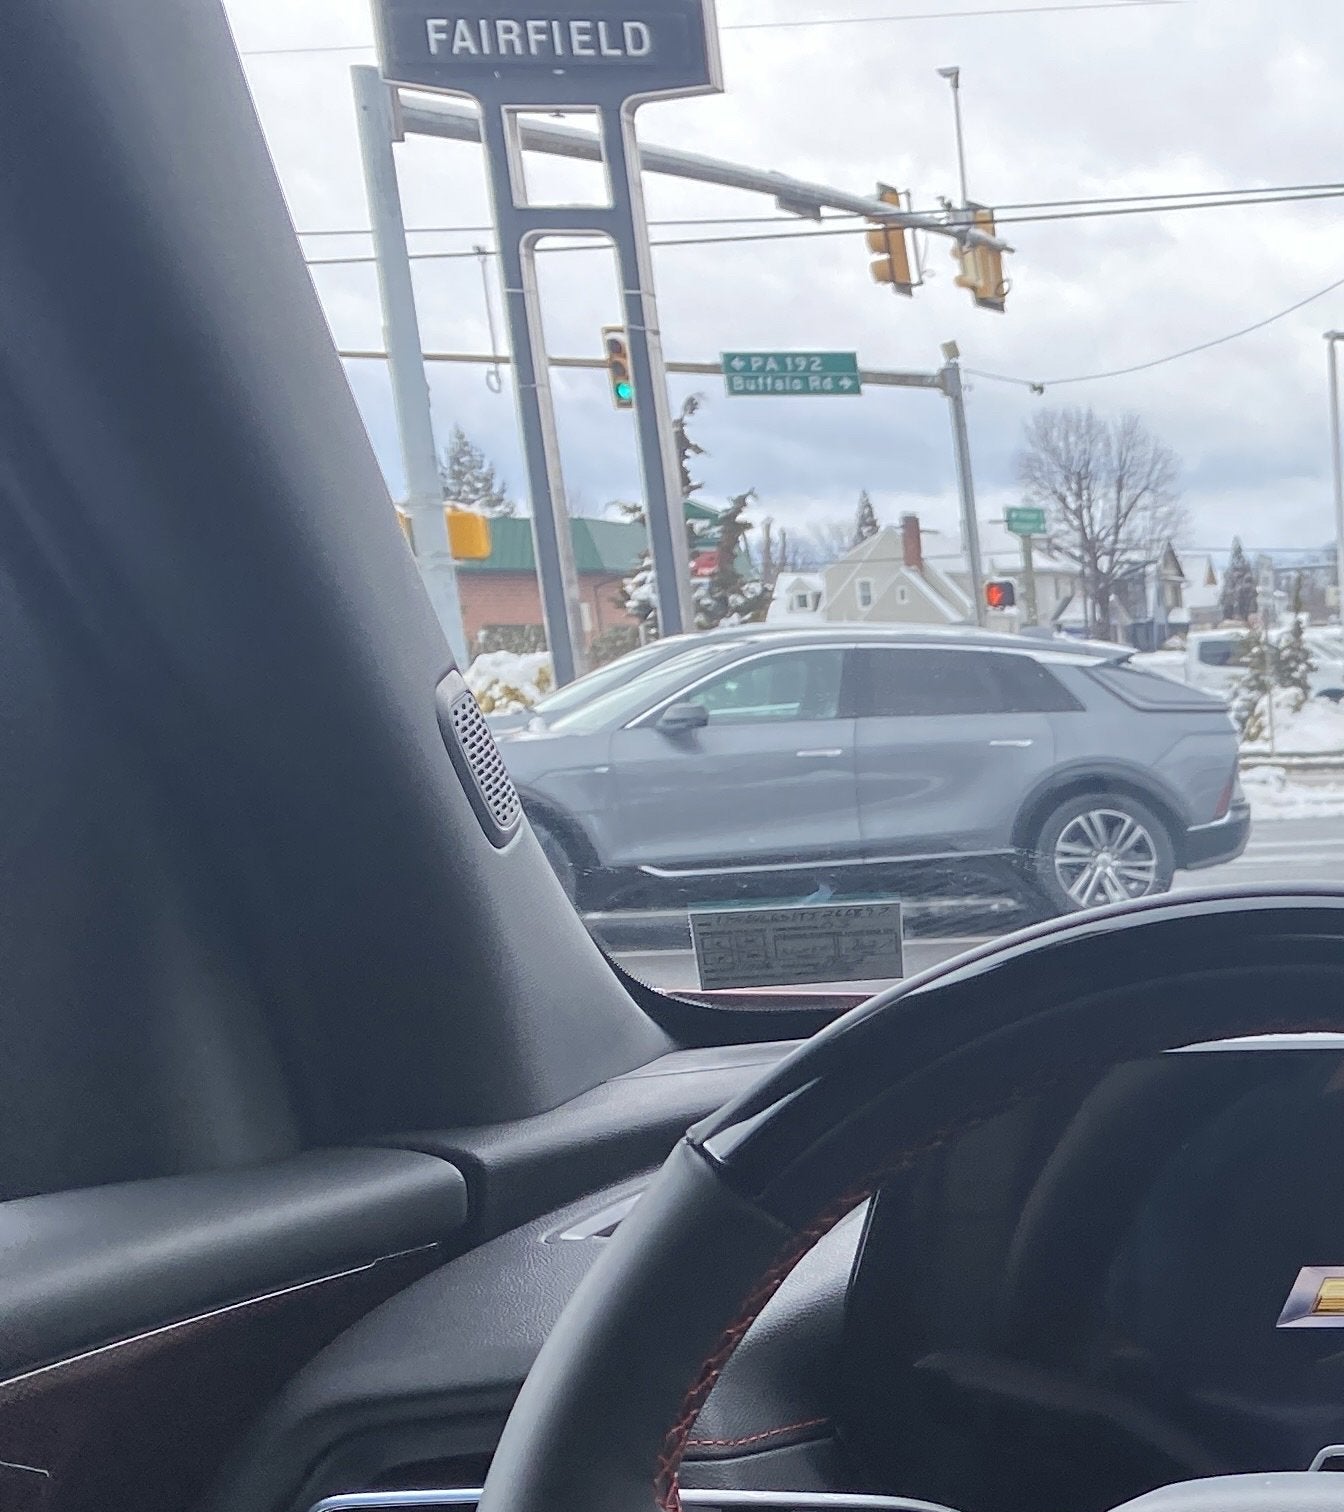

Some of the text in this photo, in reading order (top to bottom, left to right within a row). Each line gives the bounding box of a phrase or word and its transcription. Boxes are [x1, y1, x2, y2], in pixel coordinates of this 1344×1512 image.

[426, 18, 651, 56] FAIRFIELD
[750, 356, 823, 371] PA 192
[732, 375, 834, 391] Buffalo Rd
